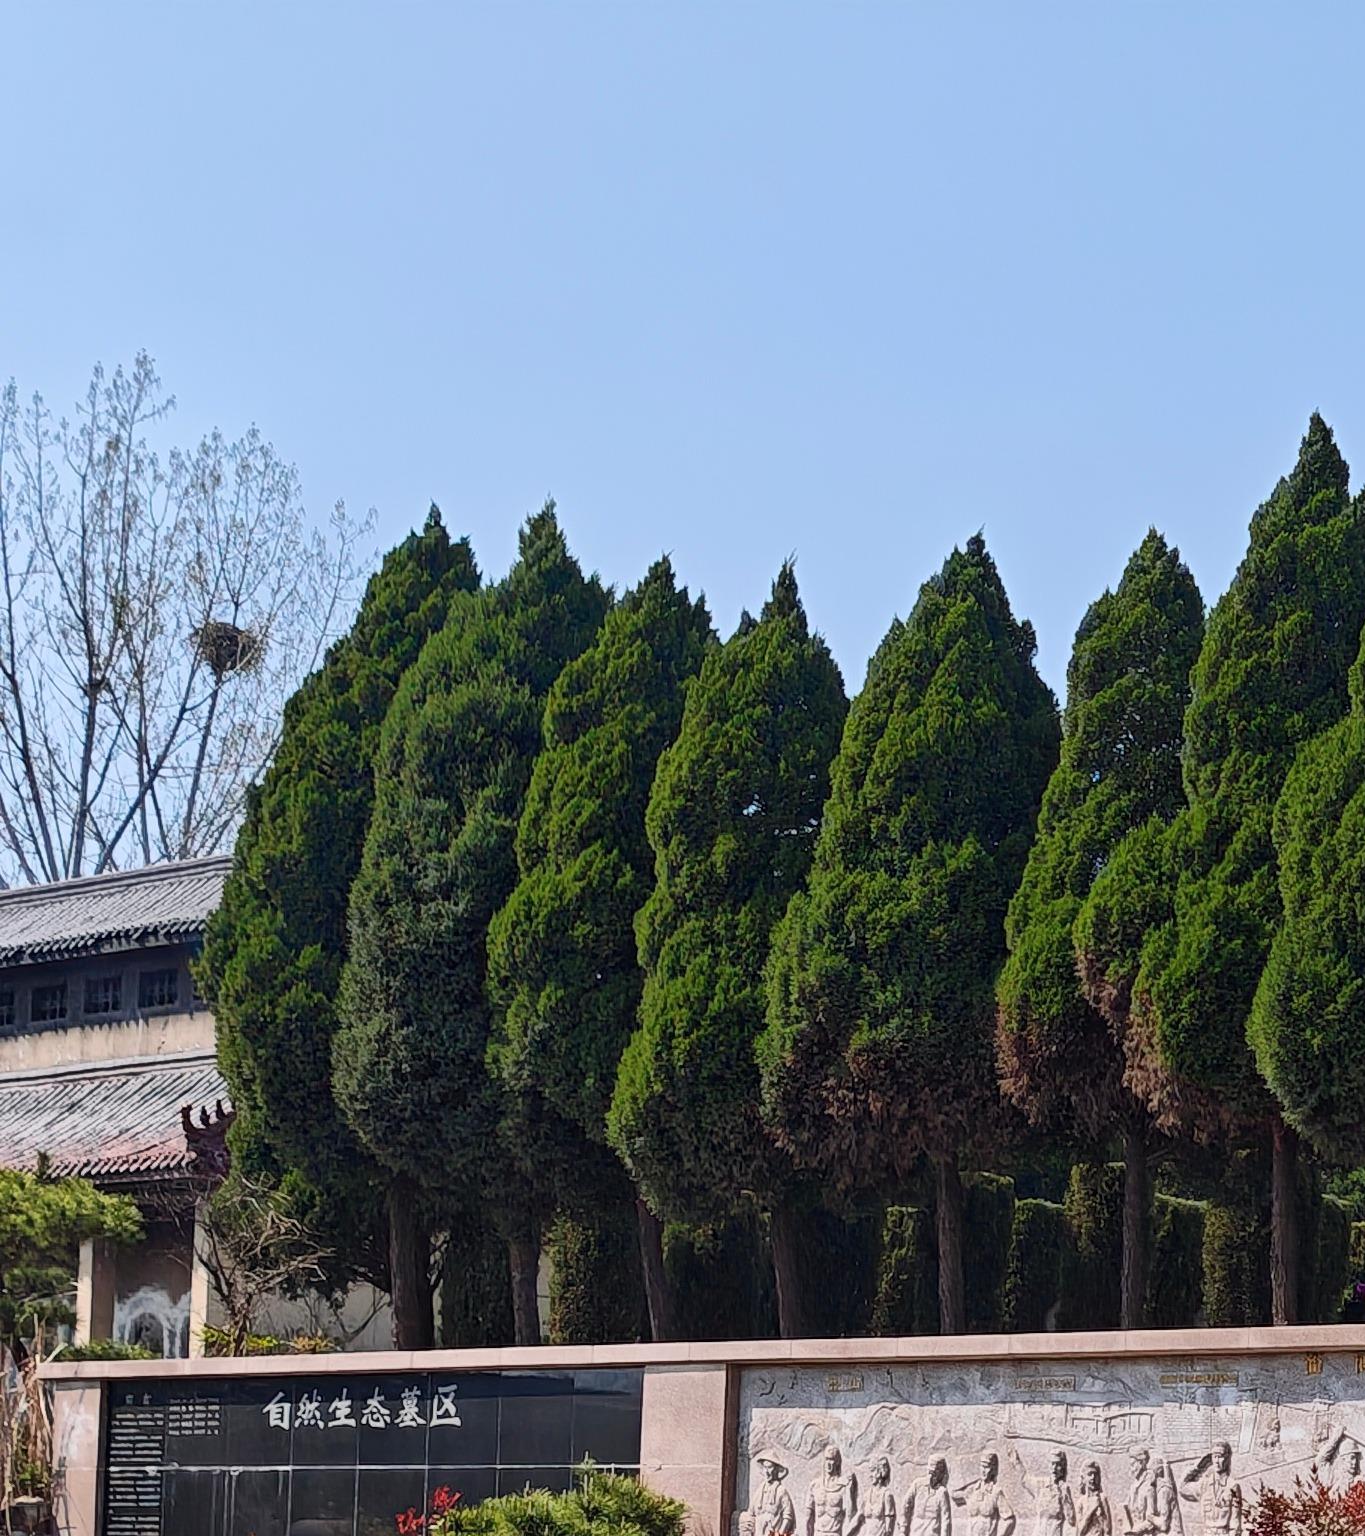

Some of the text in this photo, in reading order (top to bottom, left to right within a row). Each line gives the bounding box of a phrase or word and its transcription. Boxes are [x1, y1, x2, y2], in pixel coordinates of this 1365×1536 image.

[262, 1384, 462, 1430] 自然生态墓区
